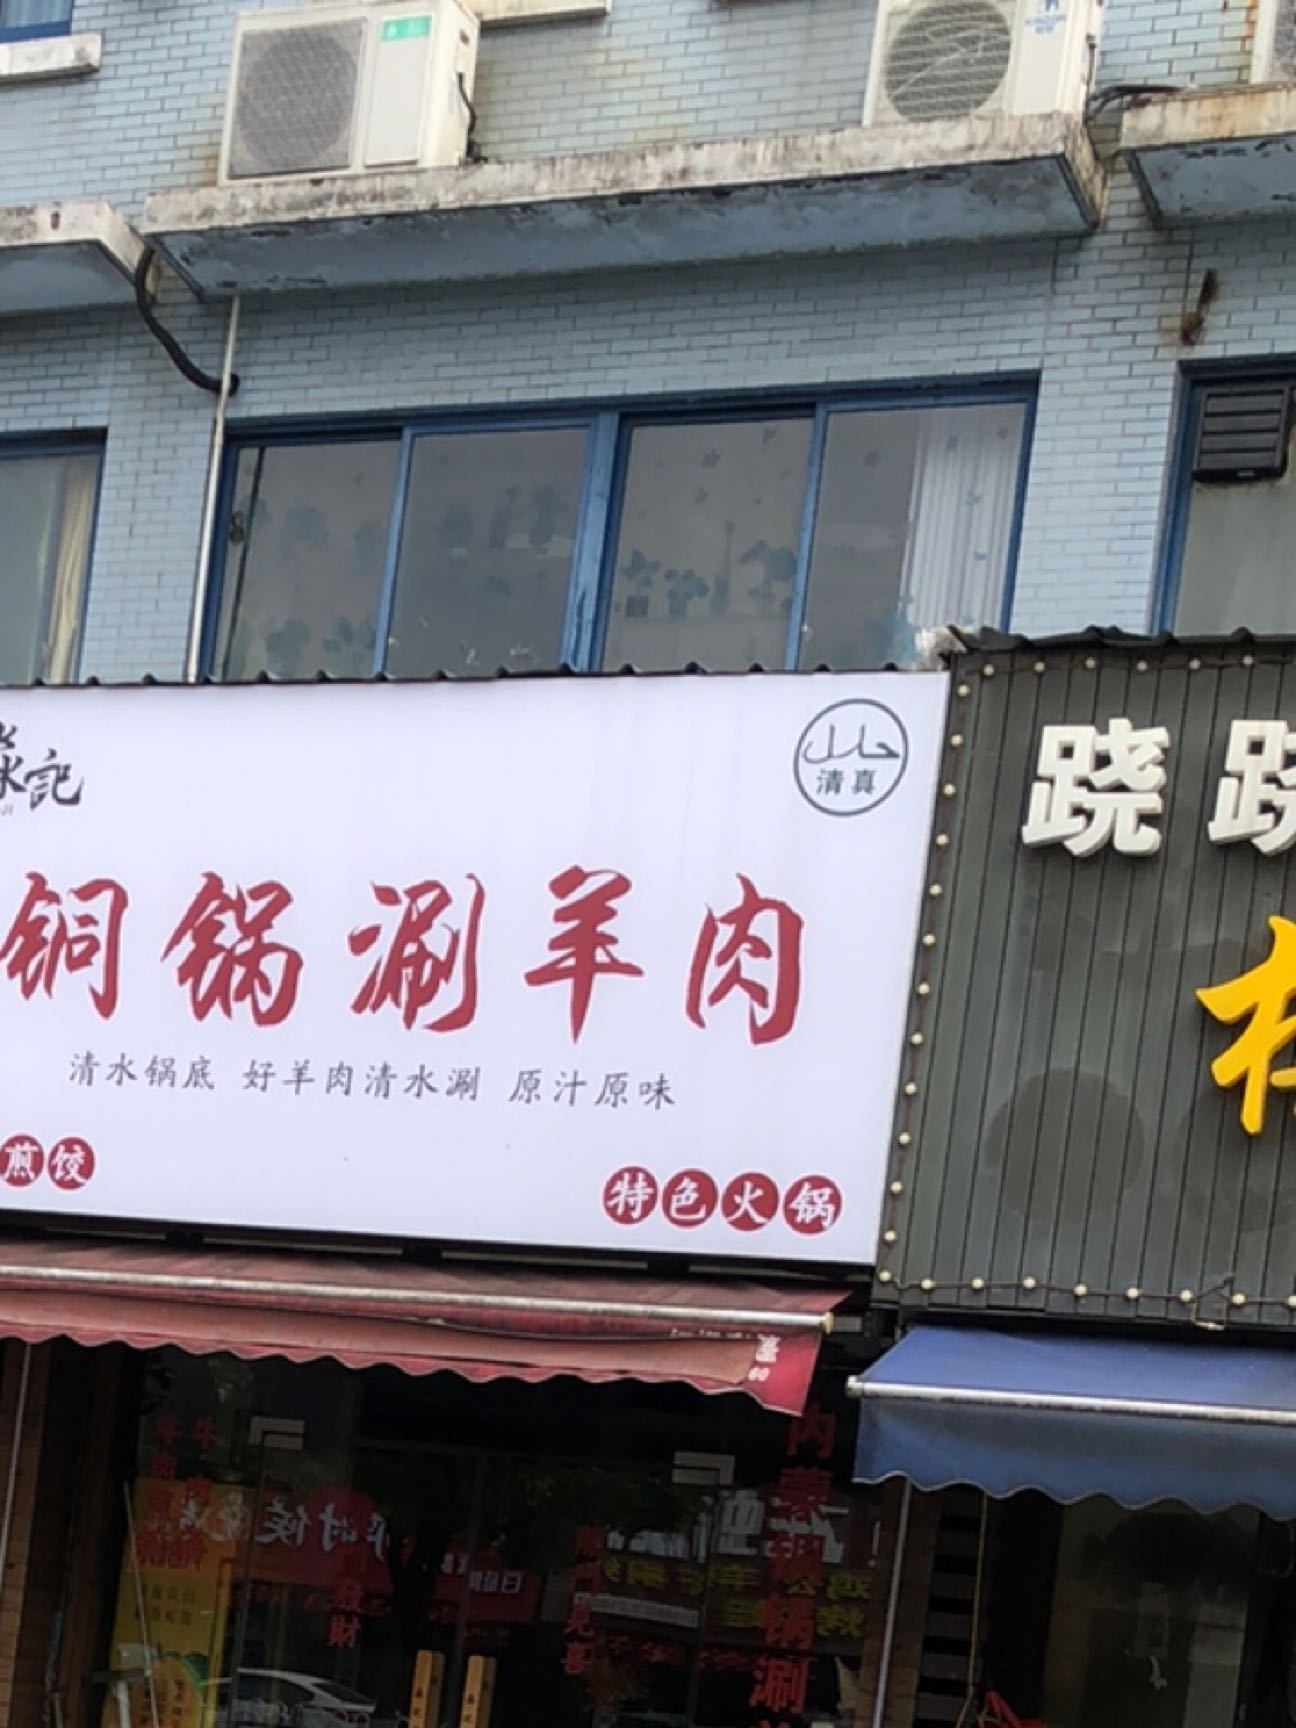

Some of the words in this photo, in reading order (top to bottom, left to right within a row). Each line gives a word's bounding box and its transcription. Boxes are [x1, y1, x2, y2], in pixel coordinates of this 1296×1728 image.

[816, 767, 877, 795] 清真
[69, 1049, 216, 1091] 清水锅底
[242, 1059, 482, 1102] 好羊肉清水涮
[509, 1068, 677, 1111] 原汁原味
[606, 1171, 838, 1229] 特色火锅
